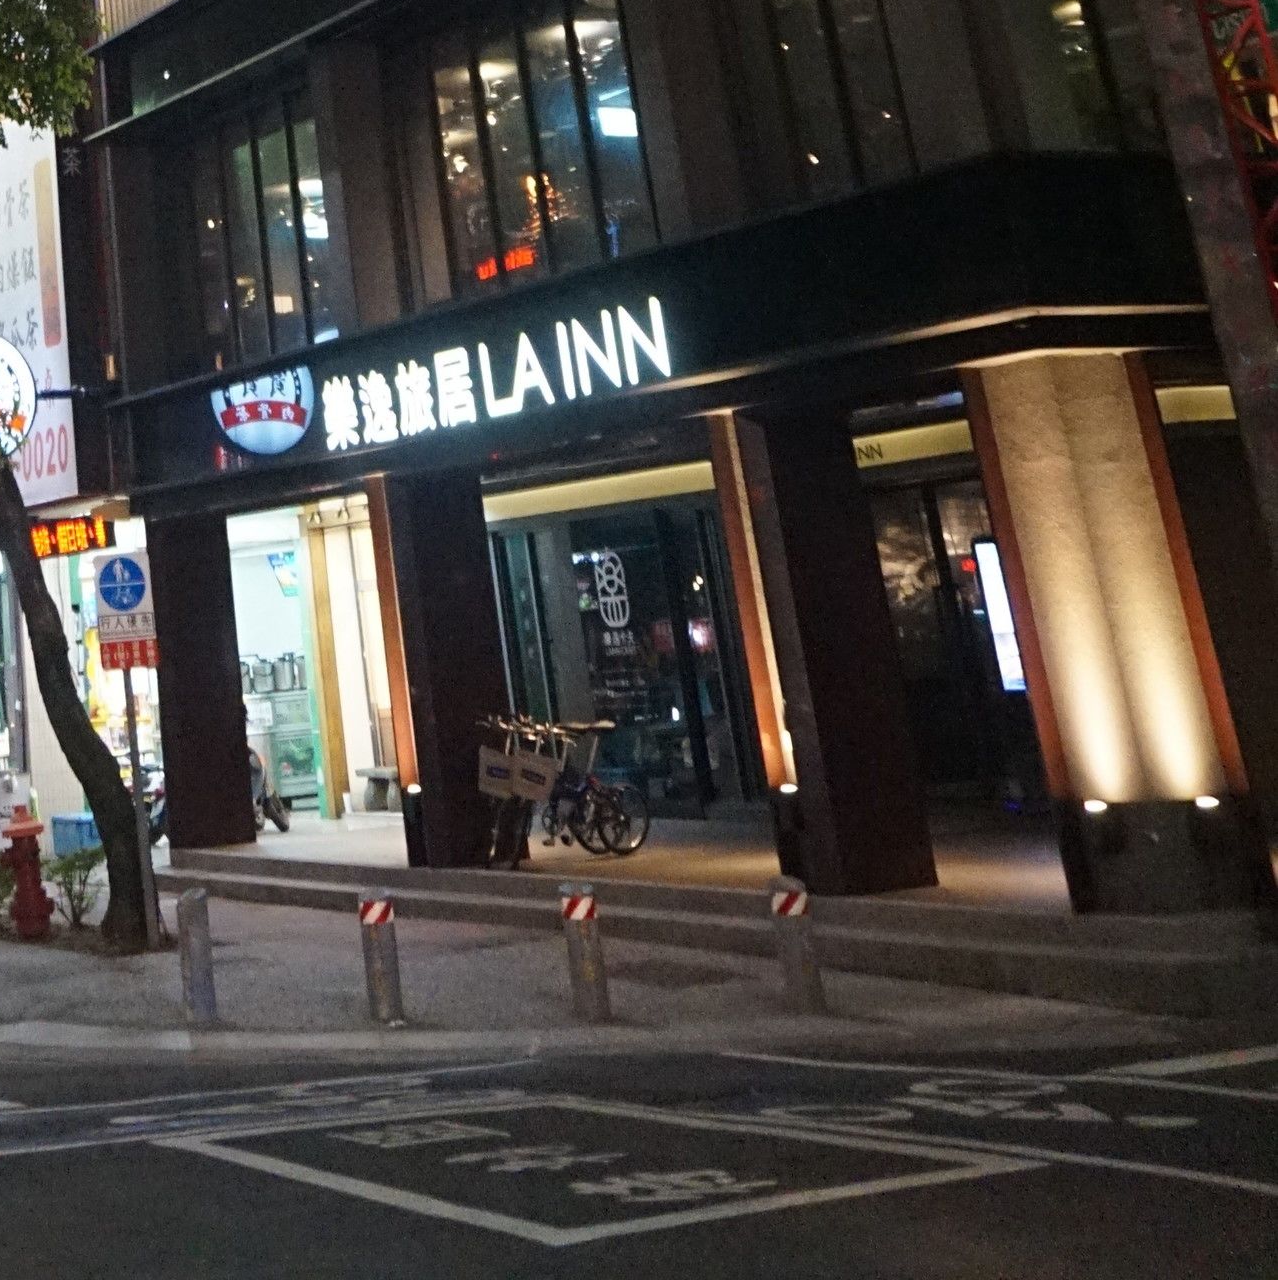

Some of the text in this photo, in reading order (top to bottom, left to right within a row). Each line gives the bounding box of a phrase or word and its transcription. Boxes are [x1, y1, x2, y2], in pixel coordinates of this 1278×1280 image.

[321, 296, 671, 451] 樂逸旅居 LA INN
